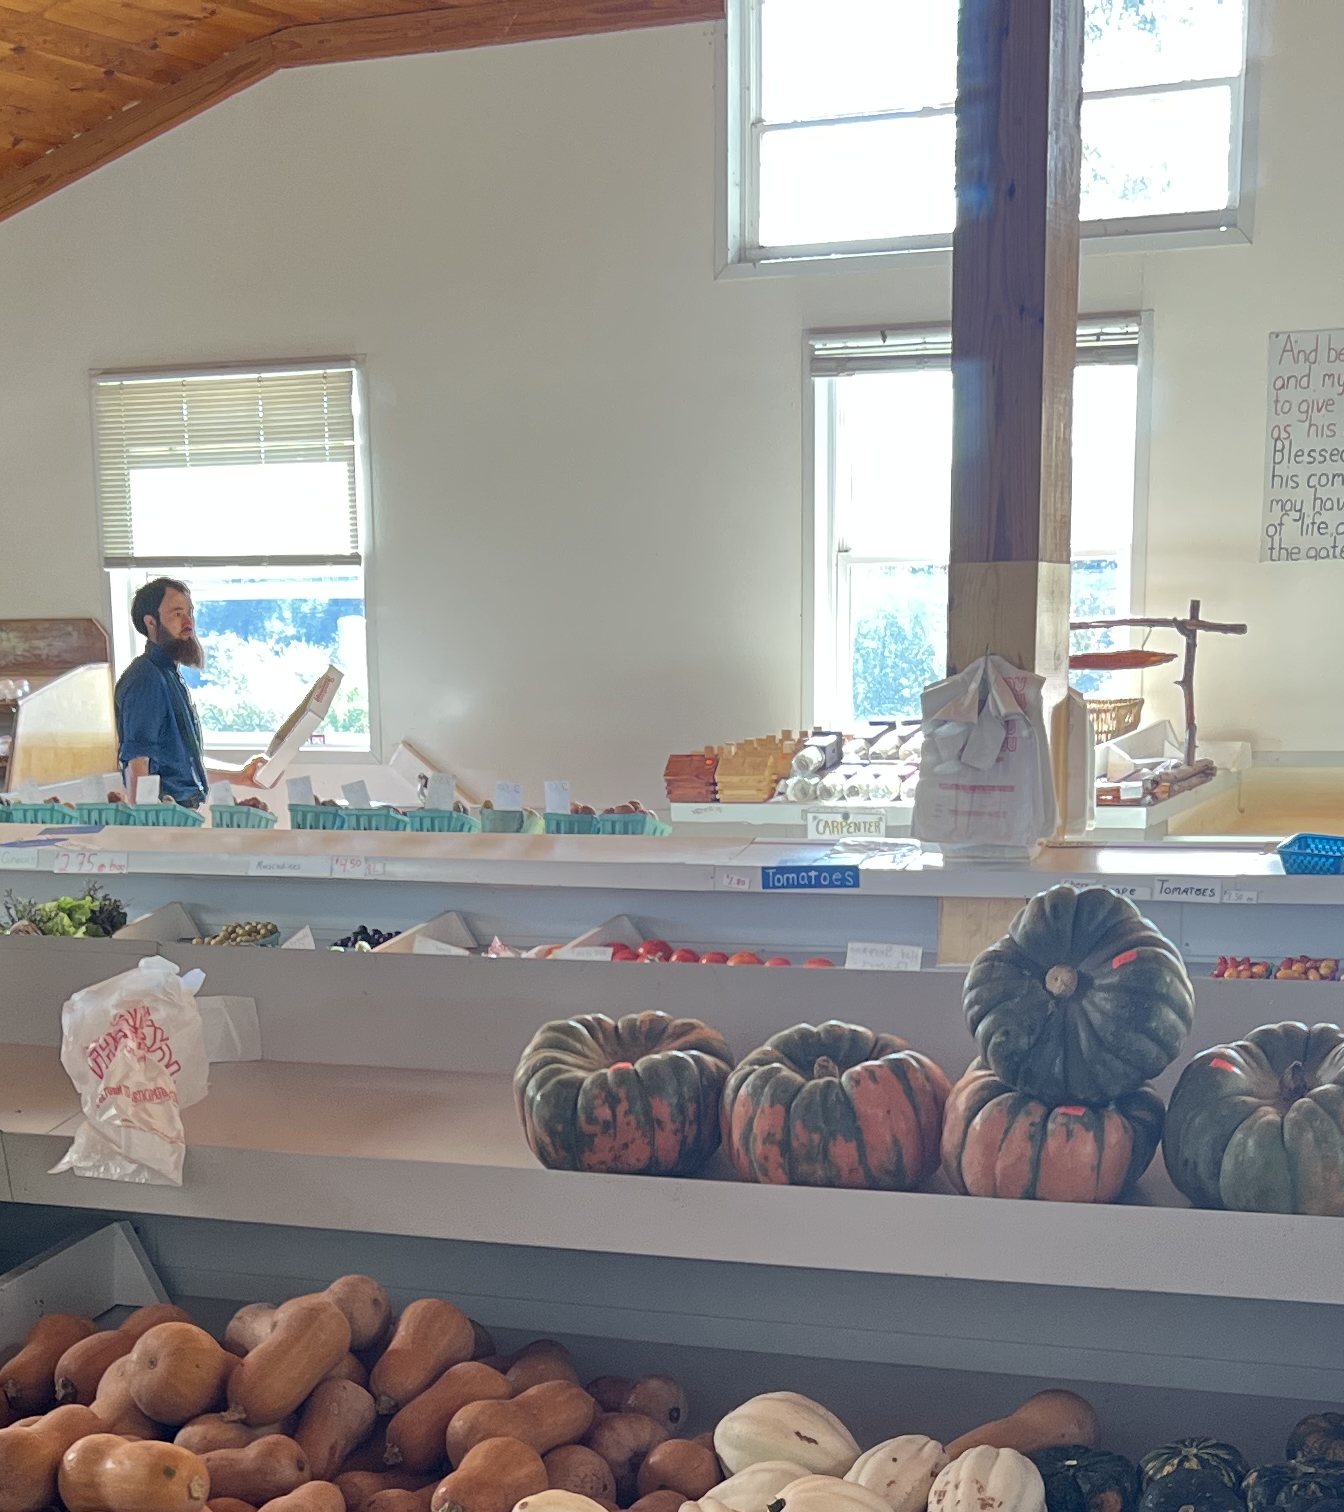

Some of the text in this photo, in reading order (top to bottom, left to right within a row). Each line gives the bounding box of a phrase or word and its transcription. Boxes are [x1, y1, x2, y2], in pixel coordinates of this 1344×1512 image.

[1273, 365, 1311, 391] and
[1273, 391, 1292, 416] to
[1297, 398, 1335, 423] give
[1271, 424, 1292, 440] as
[1307, 413, 1336, 438] his
[1271, 465, 1299, 489] his
[1269, 499, 1304, 522] may
[1265, 512, 1290, 537] of
[1268, 536, 1301, 561] the
[765, 869, 854, 887] Tomatoes
